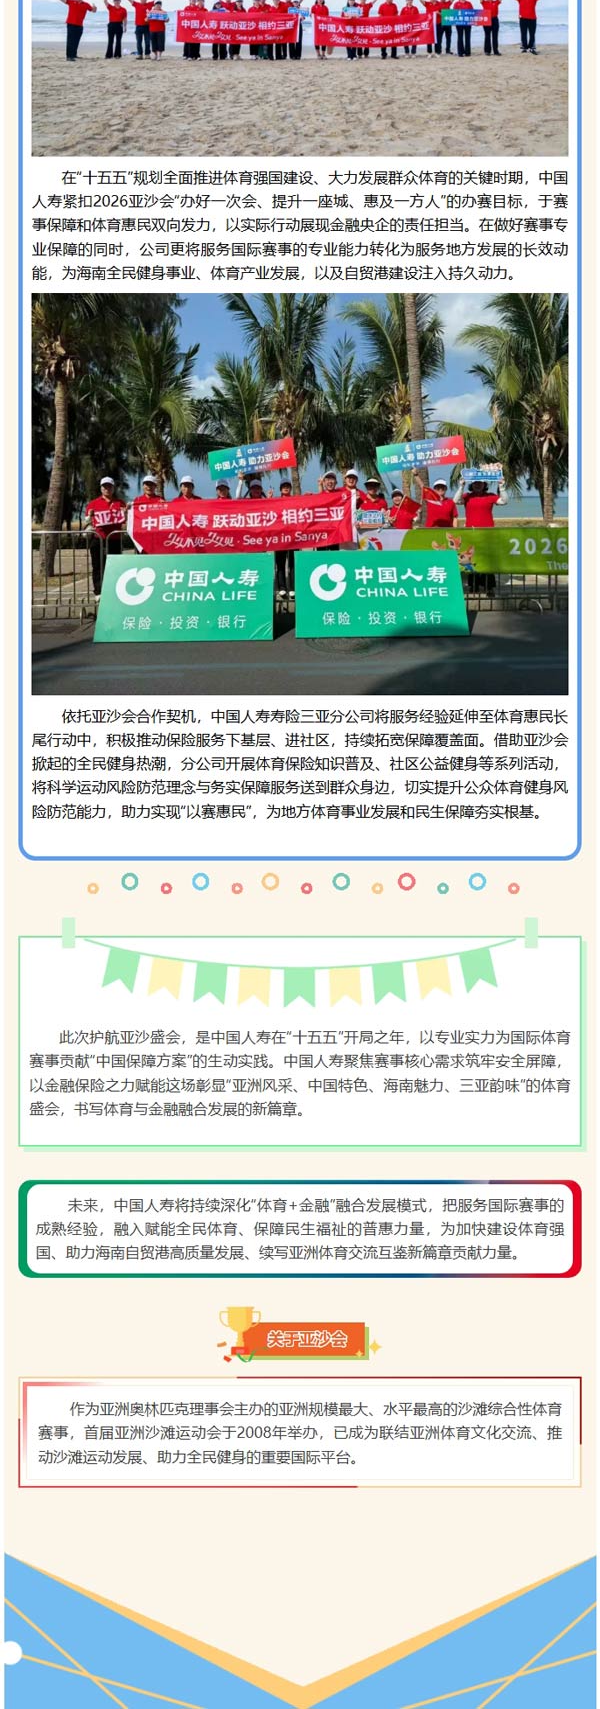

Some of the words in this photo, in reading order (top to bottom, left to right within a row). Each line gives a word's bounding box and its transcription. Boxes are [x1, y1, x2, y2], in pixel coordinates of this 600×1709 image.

[181, 19, 218, 30] 中国人寿
[219, 20, 257, 30] 跃动亚沙
[258, 20, 295, 31] 相约三亚
[318, 23, 353, 34] 中国人寿
[356, 24, 392, 35] 跃动亚沙
[394, 21, 430, 33] 相约三亚
[32, 217, 568, 233] 事保障和体育惠民双向发力，以实际行动展现金融央企的责任担当。在做好赛事专
[32, 241, 568, 257] 业保障的同时，公司更将服务国际赛事的专业能力转化为服务地方发展的长效动
[32, 265, 515, 281] 能，为海南全民健身事业、体育产业发展，以及自贸港建设注入持久动力。
[214, 458, 247, 472] 中国人寿
[248, 450, 290, 465] 助力亚沙会
[382, 454, 415, 465] 中国人寿
[416, 447, 460, 460] 助力亚沙会
[141, 514, 208, 531] 中国人寿
[213, 511, 277, 529] 跃动亚沙
[281, 506, 345, 525] 相约三亚
[242, 535, 262, 545] See
[265, 536, 279, 547] ya
[281, 533, 291, 543] in
[295, 531, 328, 543] Sanya
[509, 537, 568, 555] 2026
[546, 561, 568, 571] The
[164, 569, 260, 588] 中国人寿
[354, 566, 448, 585] 中国人寿
[162, 591, 216, 602] CHINA
[222, 590, 257, 601] LIFE
[356, 587, 409, 598] CHINA
[414, 586, 449, 597] LIFE
[62, 709, 568, 725] 依托亚沙会合作契机，中国人寿寿险三亚分公司将服务经验延伸至体育惠民长
[32, 733, 568, 748] 尾行动中，积极推动保险服务下基层、进社区，持续拓宽保障覆盖面。借助亚沙会
[32, 755, 560, 771] 掀起的全民健身热潮，分公司开展体育保险知识普及、社区公益健身等系列活动，
[32, 779, 568, 795] 将科学运动风险防范理念与务实保障服务送到群众身边，切实提升公众体育健身风
[30, 1101, 304, 1117] 盛会，书写体育与金融融合发展的新篇章。
[36, 1221, 565, 1237] 成熟经验，融入赋能全民体育、保障民生福祉的普惠力量，为加快建设体育强
[37, 1244, 519, 1261] 国、助力海南自贸港高质量发展、续写亚洲体育交流互鉴新篇章贡献力量。
[267, 1330, 348, 1348] 关于亚沙会
[70, 1402, 562, 1418] 作为亚洲奥林匹克理事会主办的亚洲规模最大、水平最高的沙滩综合性体育
[38, 1425, 562, 1441] 赛事，首届亚洲沙滩运动会于2008年举办，已成为联结亚洲体育文化交流、推
[38, 1449, 357, 1465] 动沙滩运动发展、助力全民健身的重要国际平台。
